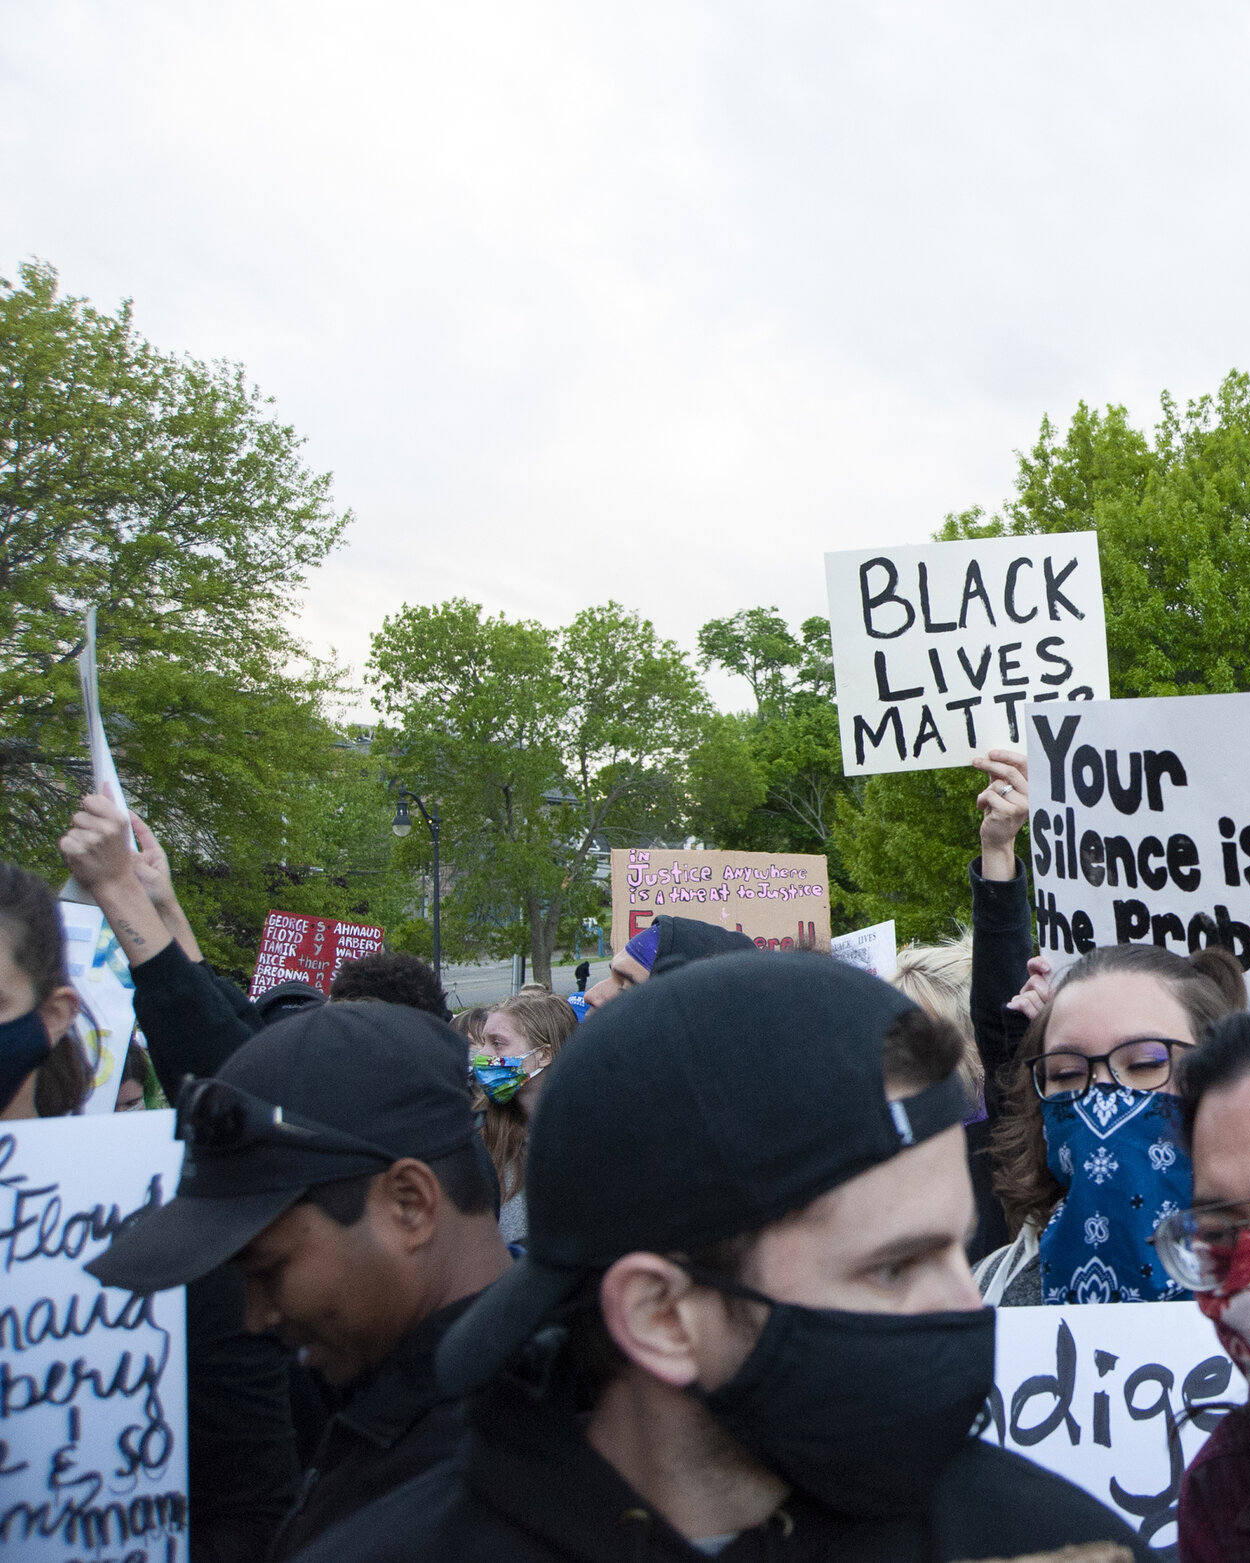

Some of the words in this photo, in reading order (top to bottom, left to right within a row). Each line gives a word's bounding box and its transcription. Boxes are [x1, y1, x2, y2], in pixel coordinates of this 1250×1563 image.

[859, 556, 1086, 639] BLACK
[874, 636, 1073, 702] LIVES
[853, 685, 1094, 766] MATT
[1032, 714, 1188, 815] Your
[1032, 806, 1201, 892] Silence
[626, 861, 712, 887] Justice
[655, 890, 666, 905] A
[737, 885, 756, 899] to
[757, 882, 823, 902] Justice
[268, 914, 309, 934] GEORGE
[333, 922, 381, 938] AHMAUD
[1035, 888, 1096, 954] the
[266, 927, 303, 944] FLOYD
[337, 936, 382, 952] ARBERY
[263, 940, 298, 957] TAMIR
[259, 952, 286, 967] RICE
[298, 954, 330, 970] their
[256, 964, 310, 982] BREONNA
